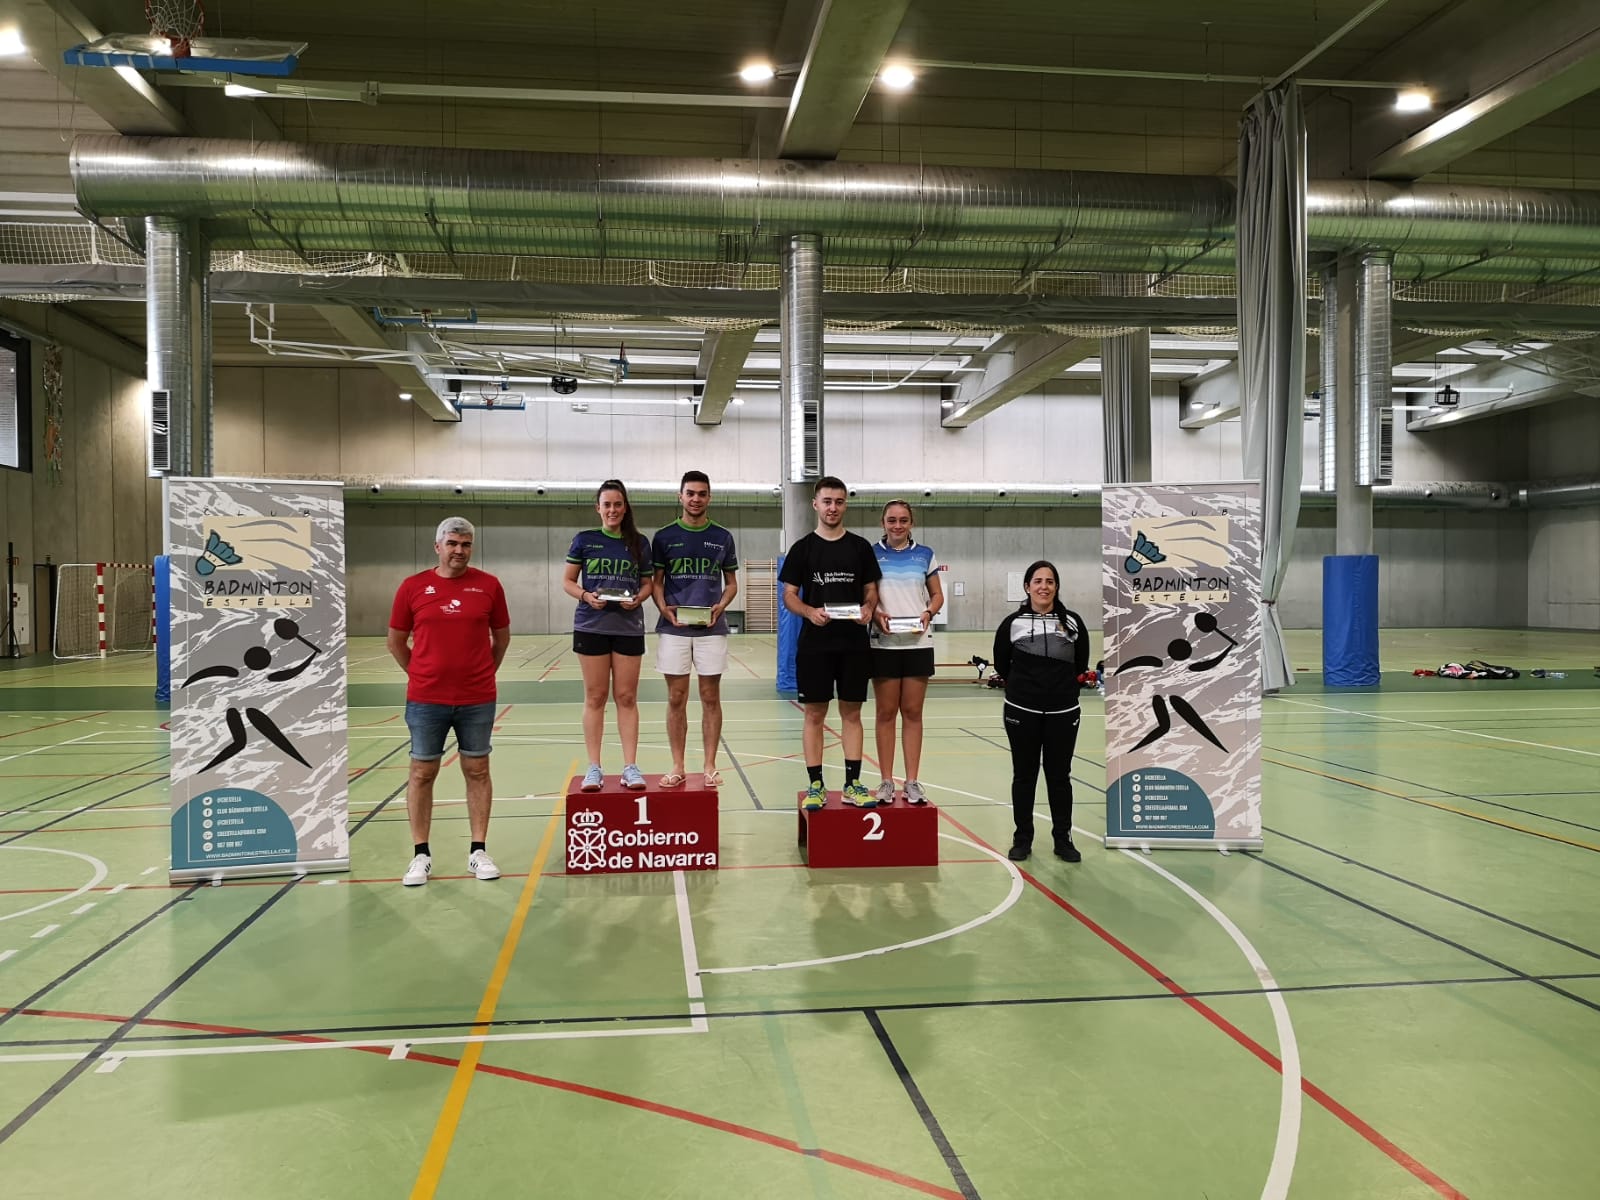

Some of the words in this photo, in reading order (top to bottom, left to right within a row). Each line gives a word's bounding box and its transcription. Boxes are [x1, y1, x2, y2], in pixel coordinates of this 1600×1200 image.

[683, 557, 721, 575] RIPA
[204, 579, 312, 596] BADMINTON
[1132, 577, 1229, 591] BADMINTON
[206, 597, 311, 607] ESTELLA
[1134, 593, 1228, 601] ESTELLA
[633, 795, 652, 825] 1
[862, 812, 885, 841] 2
[608, 829, 699, 847] Gobierno
[608, 853, 632, 869] de
[638, 852, 717, 868] Navarra
